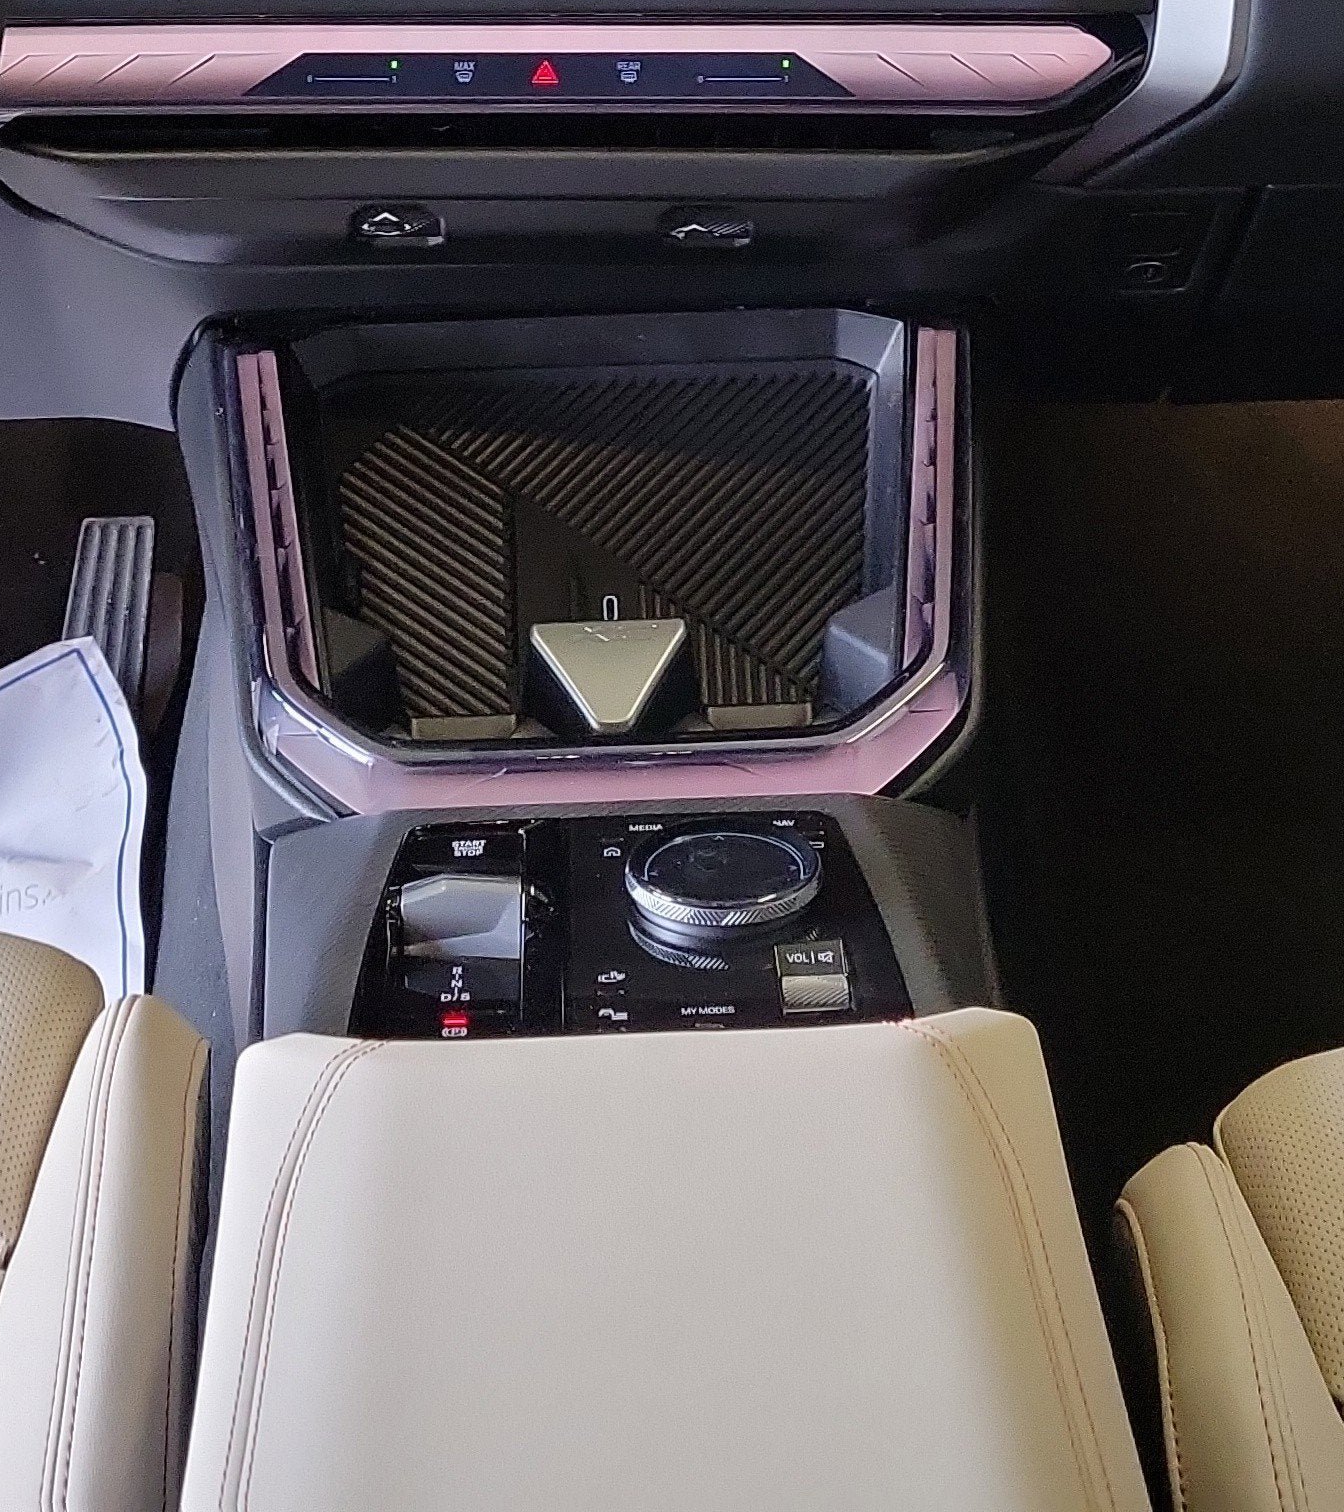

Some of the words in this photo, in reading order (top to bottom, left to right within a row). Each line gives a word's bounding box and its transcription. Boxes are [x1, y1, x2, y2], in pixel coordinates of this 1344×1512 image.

[453, 61, 476, 71] MAX
[628, 823, 663, 832] MEDIA
[451, 840, 486, 848] START
[453, 849, 485, 857] STOP
[786, 951, 808, 964] VOL
[681, 1006, 697, 1016] MY
